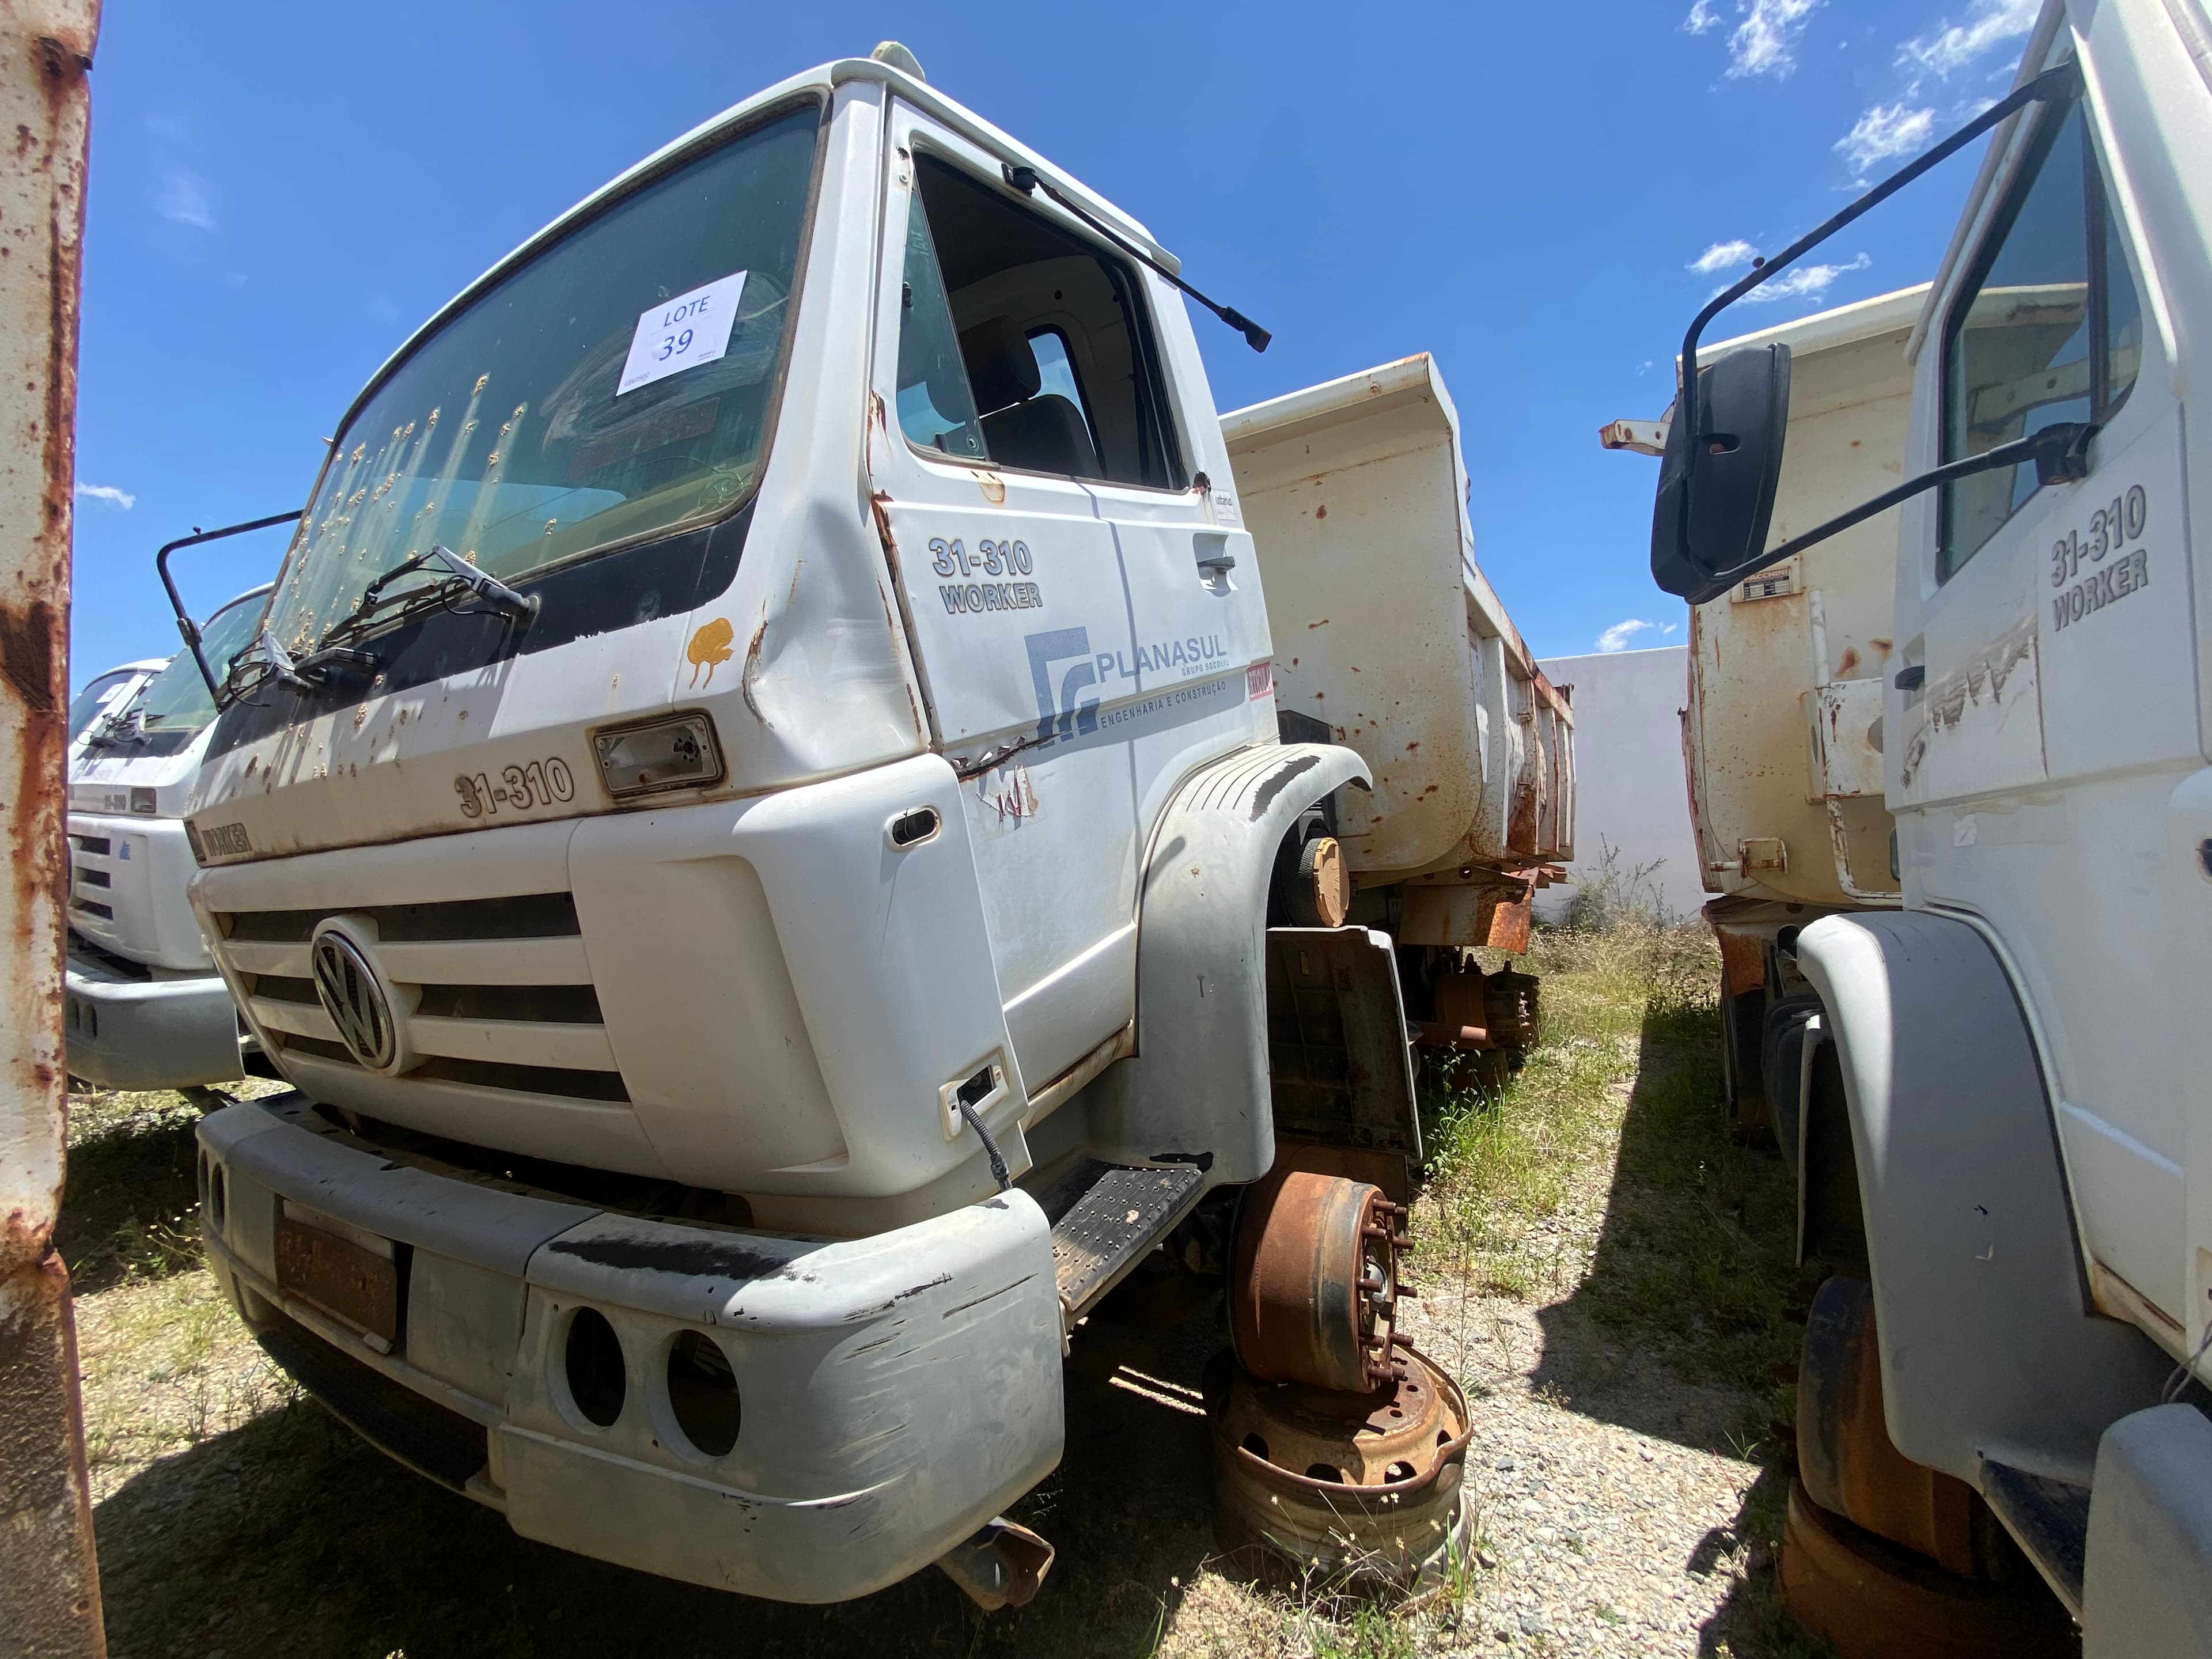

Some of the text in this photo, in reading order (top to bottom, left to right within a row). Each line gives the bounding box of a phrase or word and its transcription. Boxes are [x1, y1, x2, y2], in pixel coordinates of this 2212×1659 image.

[664, 296, 711, 327] LOTE
[659, 329, 694, 361] 39
[2051, 484, 2146, 588] 31-310
[929, 538, 1033, 577] 31-310
[939, 582, 1043, 615] WORKER
[2052, 549, 2148, 632] WORKER
[1096, 635, 1227, 684] PLANASUL
[1181, 664, 1204, 677] GRUPO
[1101, 681, 1226, 729] ENGENHARIA E CONSTRUÇÃO
[454, 757, 574, 818] 31-310
[202, 822, 253, 857] WORKER
